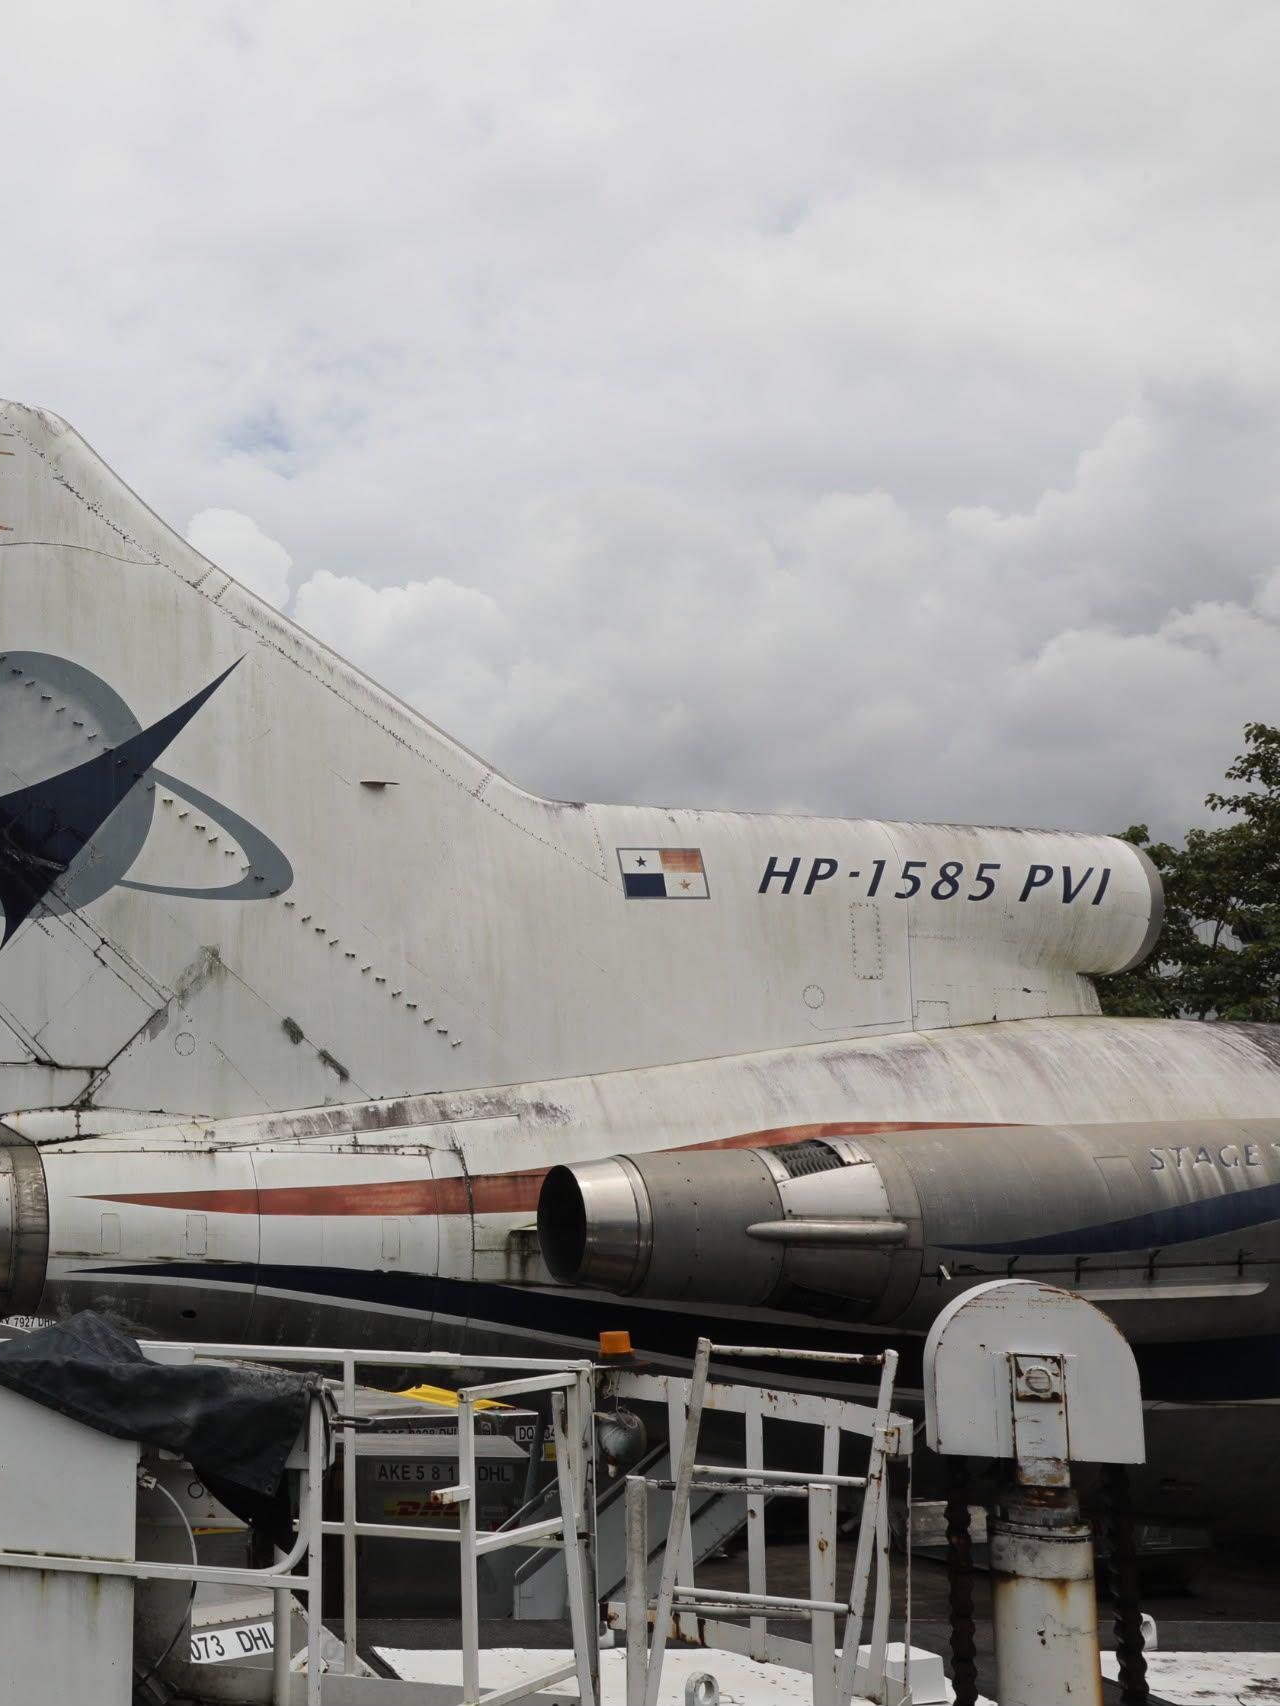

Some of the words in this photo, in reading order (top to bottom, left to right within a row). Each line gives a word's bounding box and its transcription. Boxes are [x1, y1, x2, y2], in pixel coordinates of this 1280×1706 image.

[757, 856, 1002, 902] HP-1585
[1018, 864, 1112, 906] PVI
[1150, 1143, 1262, 1170] STAGE
[519, 1426, 534, 1440] DQ
[377, 1464, 411, 1481] AKE
[477, 1466, 511, 1482] DHL
[235, 1627, 274, 1653] DHL
